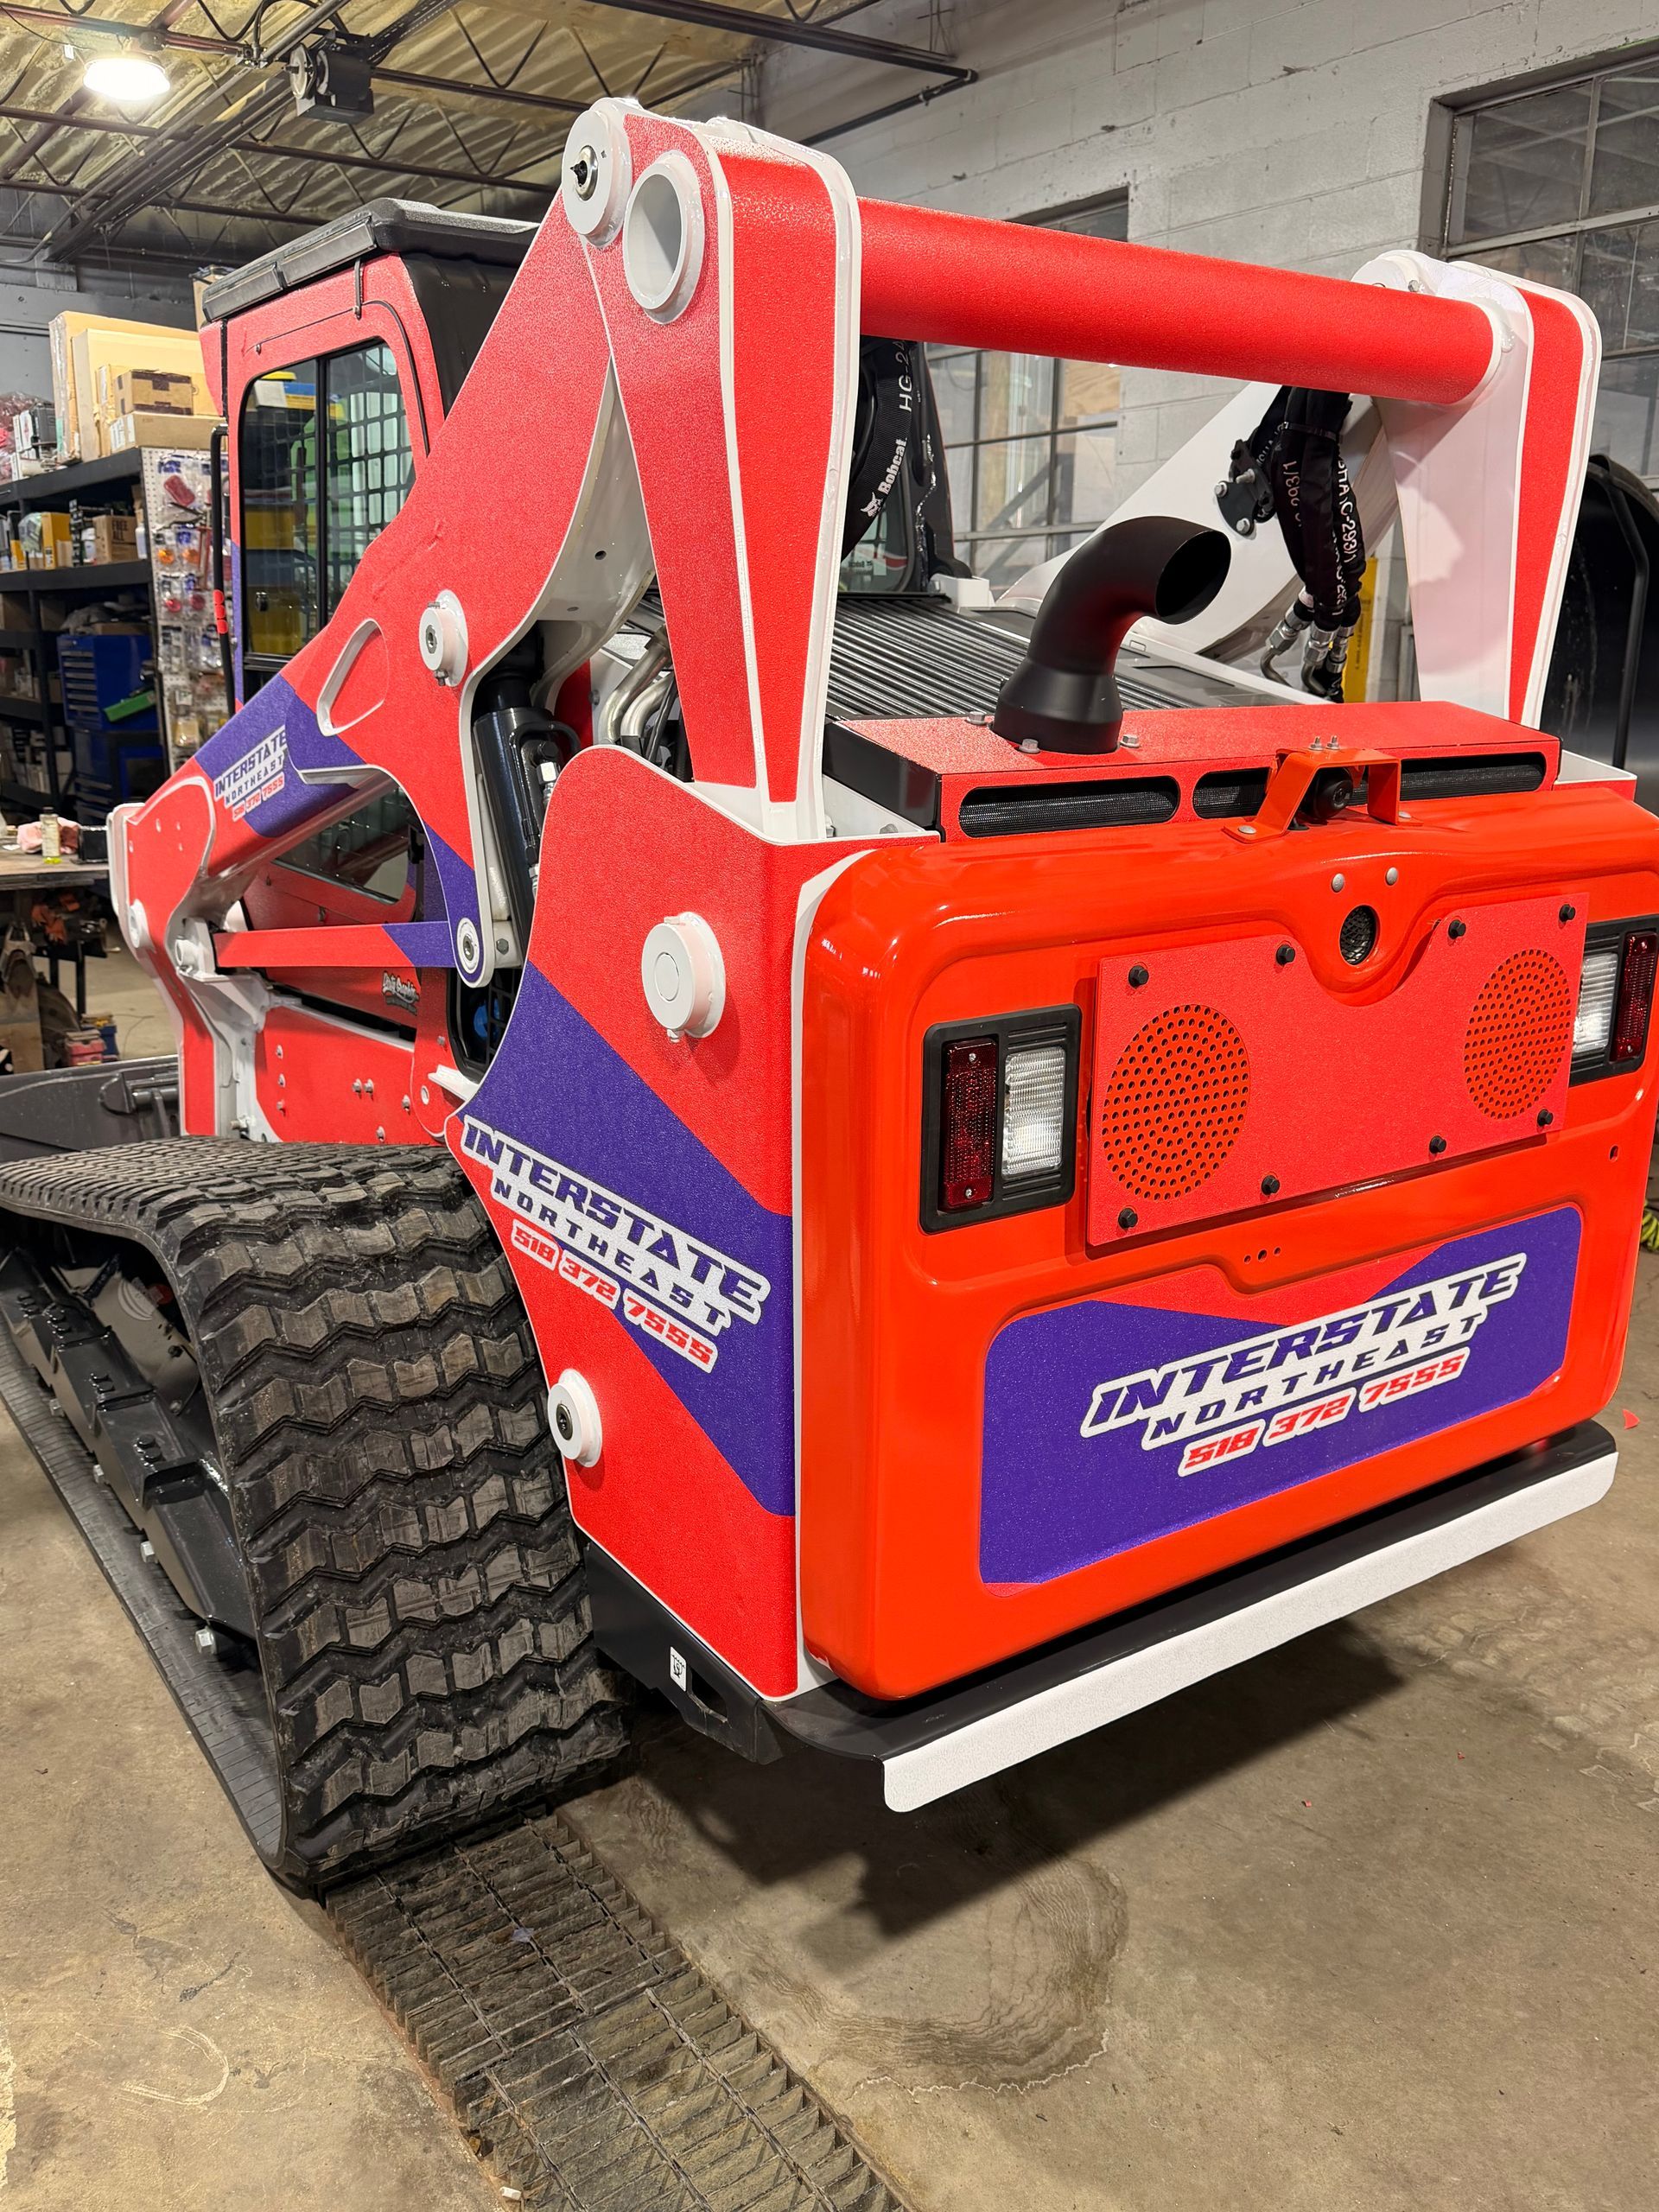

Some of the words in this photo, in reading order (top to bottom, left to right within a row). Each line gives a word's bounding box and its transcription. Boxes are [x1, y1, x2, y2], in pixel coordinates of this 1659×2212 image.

[877, 437, 907, 496] Bobcat
[214, 729, 288, 798] INTERSTATE
[225, 754, 283, 804] NORTHEAST
[262, 776, 284, 798] 7555
[464, 1124, 762, 1315] INTERSTATE
[493, 1179, 727, 1327] NORTHEAST
[513, 1227, 557, 1262] 518
[562, 1255, 618, 1302] 372
[626, 1294, 714, 1365] 7555
[1092, 1261, 1522, 1423] INTERSTATE
[1147, 1312, 1483, 1441] NORTHEAST
[1184, 1427, 1259, 1469] 518
[1267, 1394, 1353, 1440] 372
[1364, 1352, 1465, 1406] 7555
